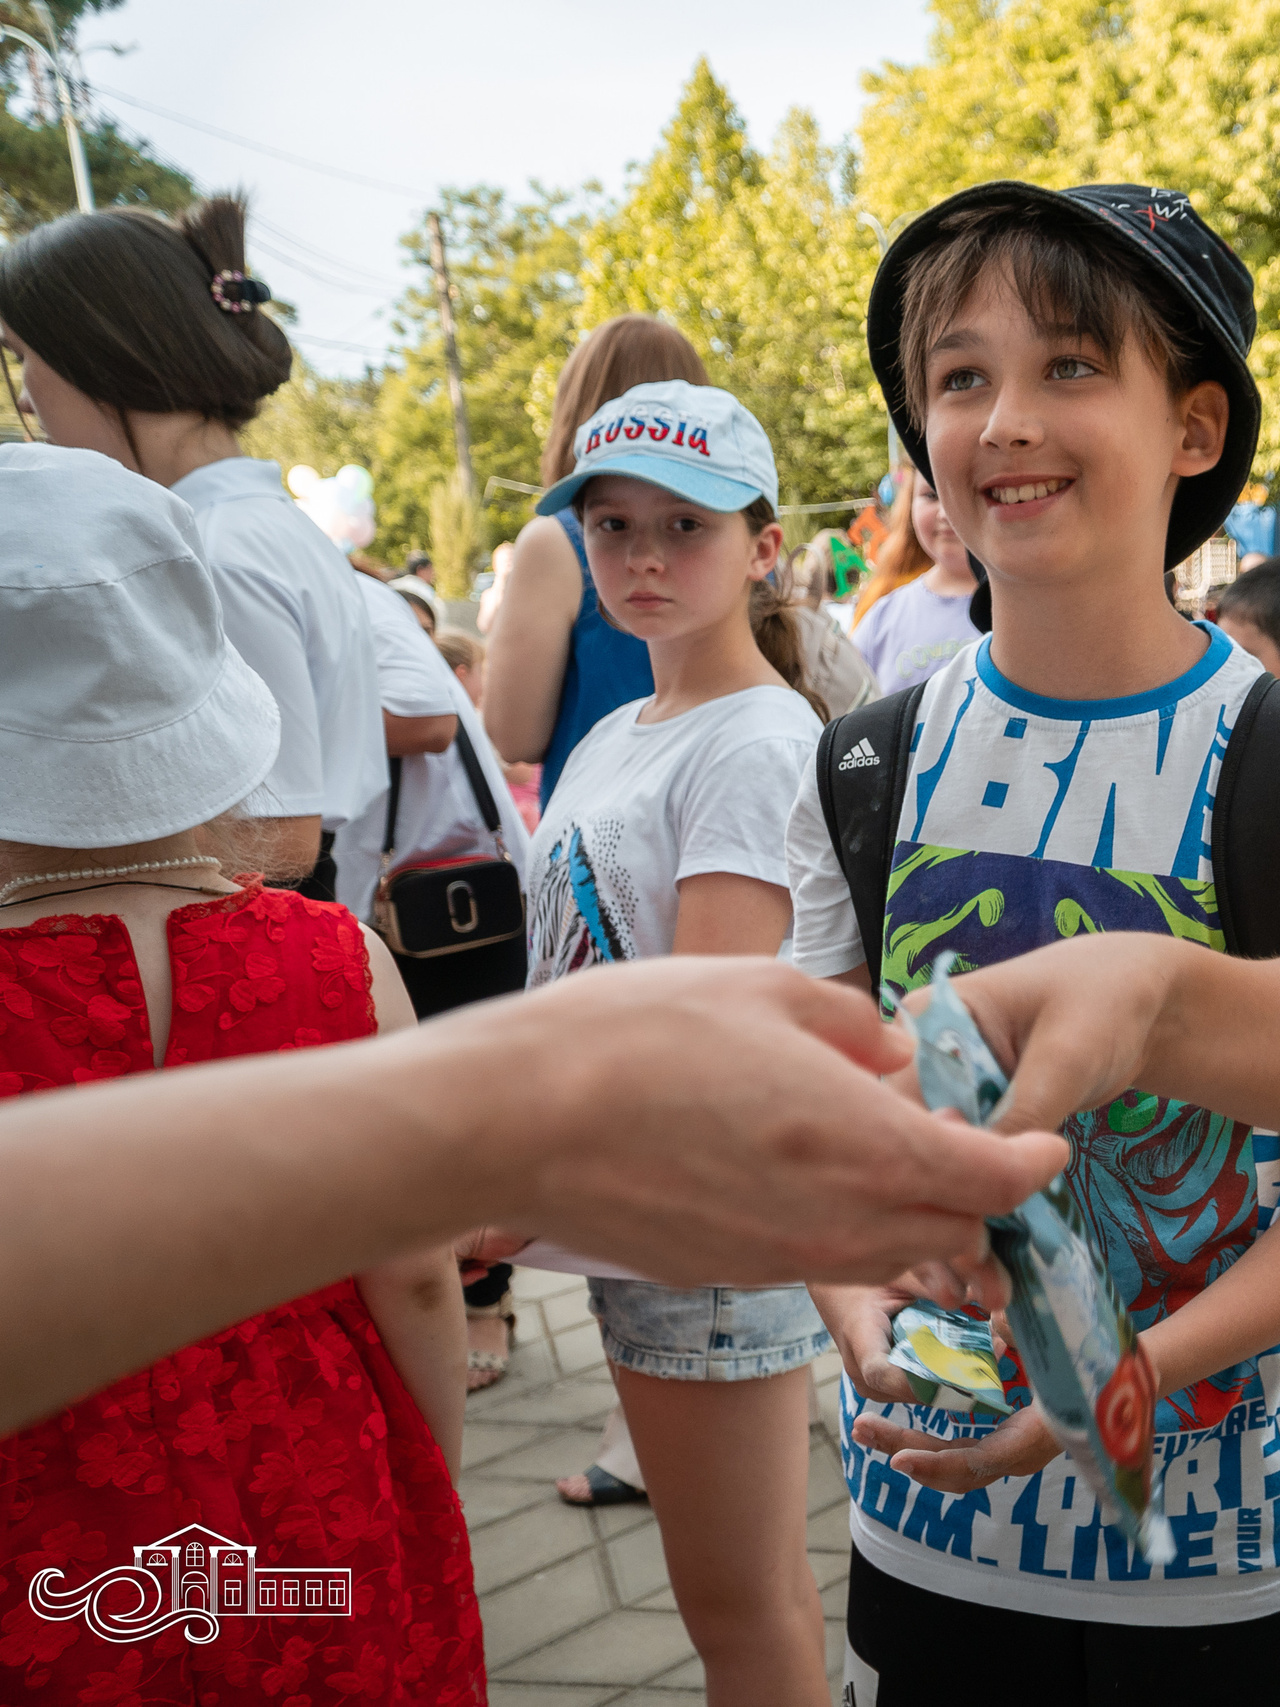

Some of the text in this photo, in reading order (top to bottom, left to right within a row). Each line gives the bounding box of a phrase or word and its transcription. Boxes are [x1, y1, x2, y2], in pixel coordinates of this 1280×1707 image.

[584, 405, 711, 457] RUSSIA
[838, 756, 880, 771] adidas
[1237, 1507, 1263, 1575] YOUR
